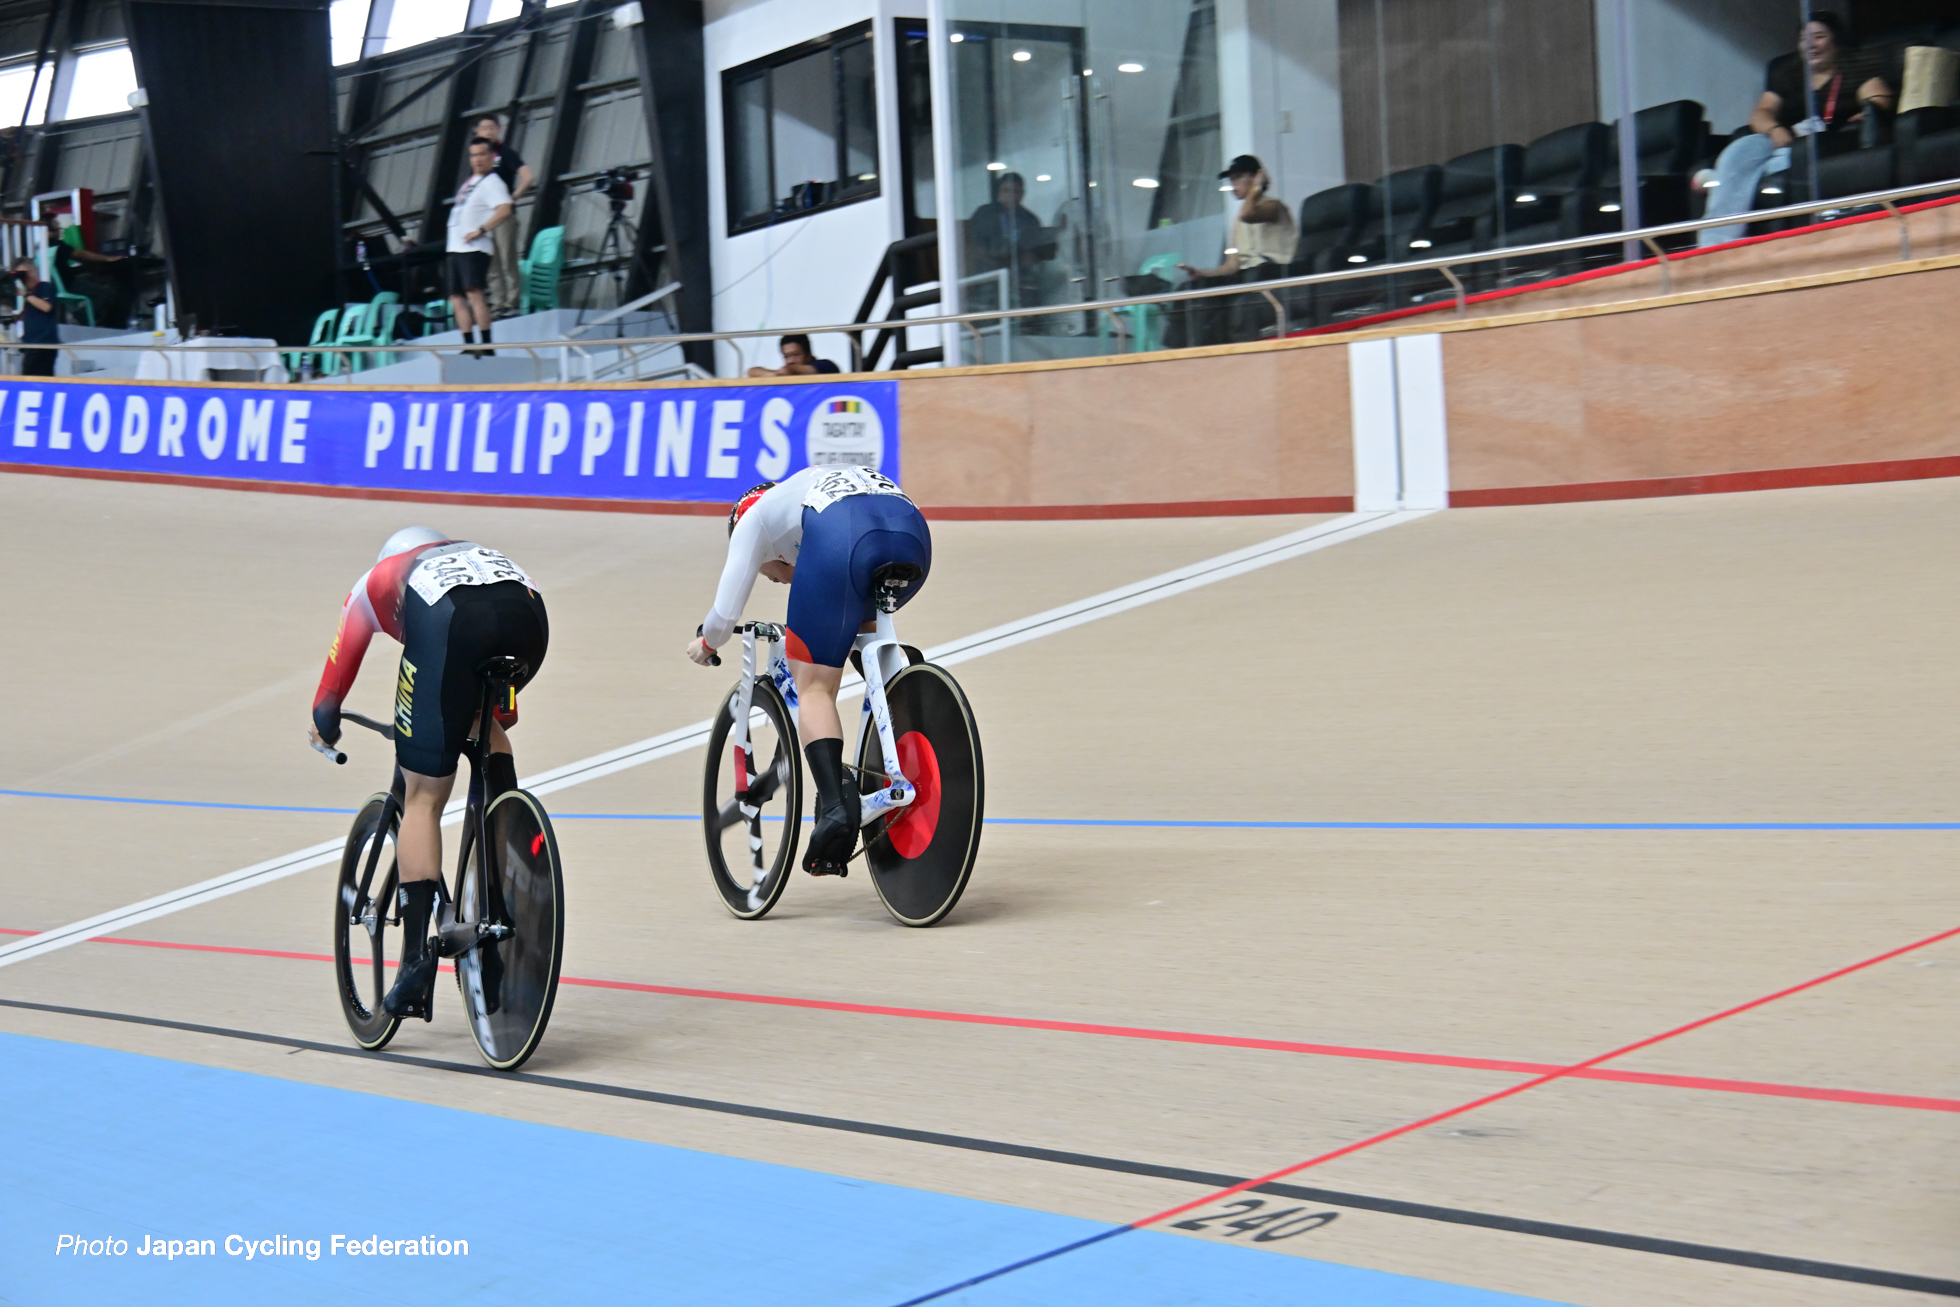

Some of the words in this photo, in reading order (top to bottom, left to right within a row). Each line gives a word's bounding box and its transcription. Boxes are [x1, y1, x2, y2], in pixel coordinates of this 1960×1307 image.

[0, 390, 312, 464] ELODROME
[364, 397, 795, 481] PHILIPPINES
[423, 556, 474, 588] 346
[395, 655, 418, 738] CHINA
[1170, 1198, 1340, 1243] 240
